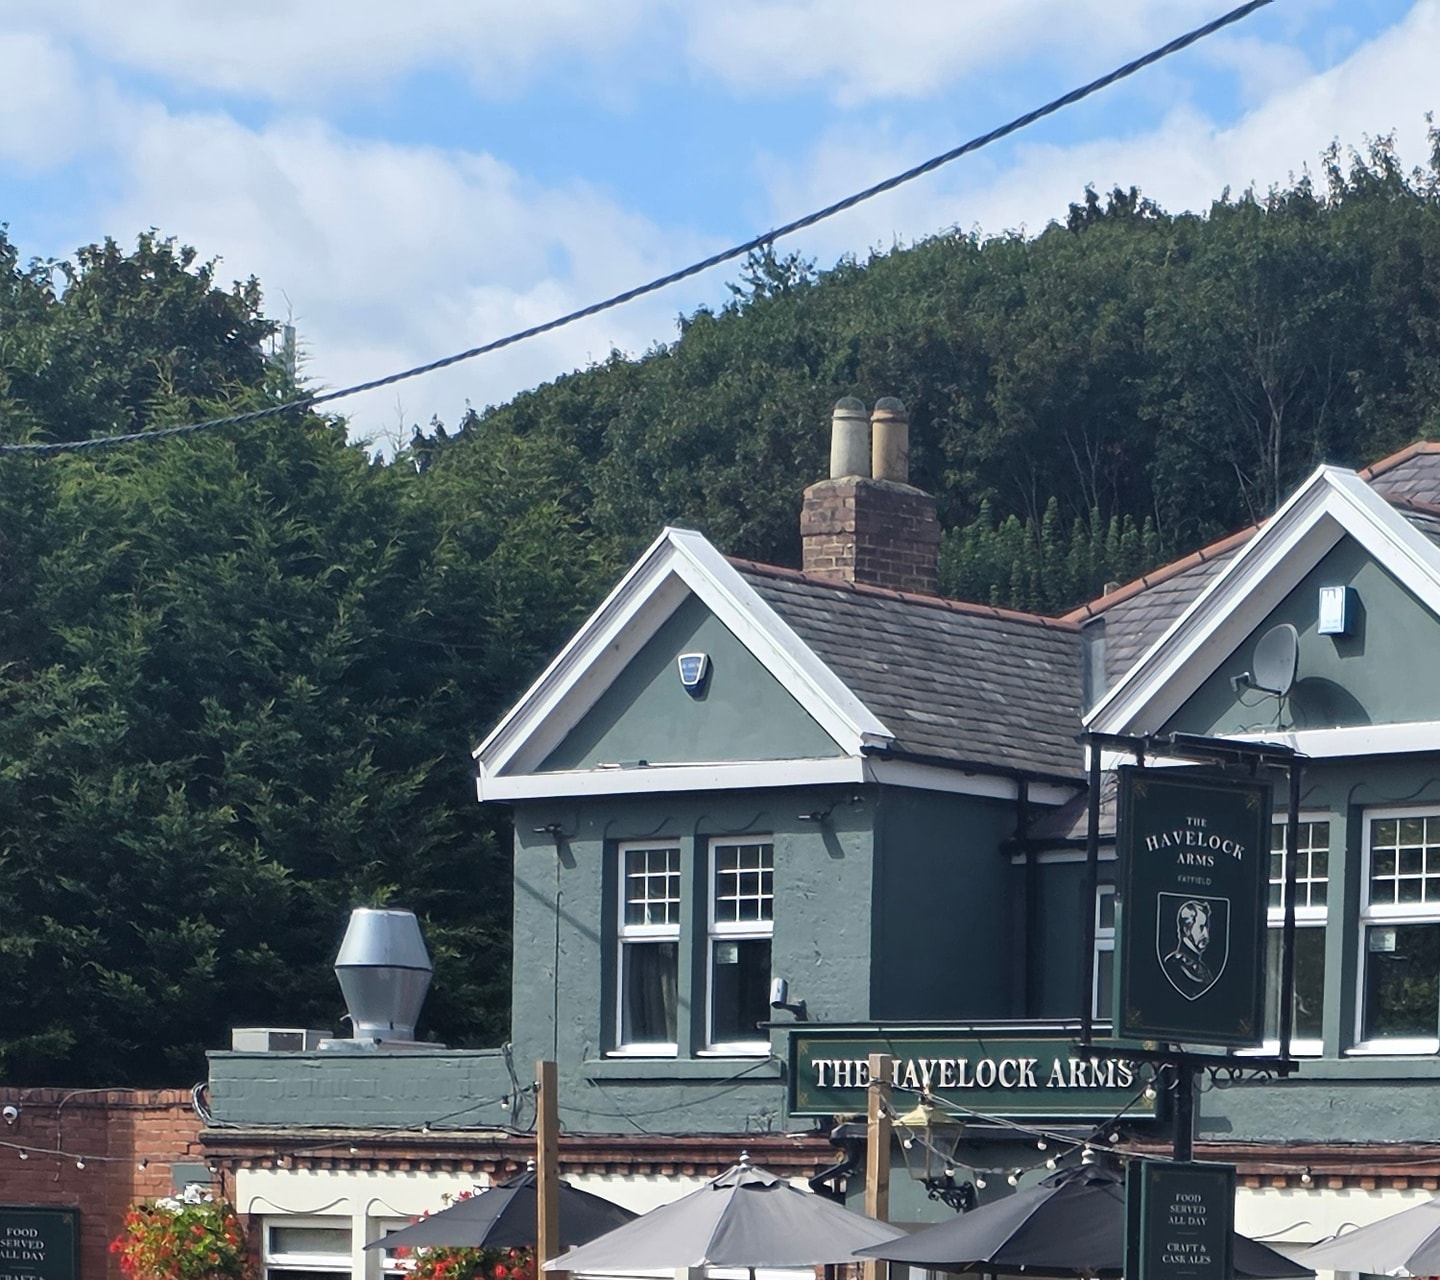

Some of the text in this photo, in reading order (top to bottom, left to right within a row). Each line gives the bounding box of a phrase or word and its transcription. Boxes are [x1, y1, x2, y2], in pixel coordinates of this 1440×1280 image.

[1186, 816, 1207, 828] THE
[1145, 831, 1246, 861] HAVELOCK
[1177, 853, 1215, 867] ARMS
[1178, 875, 1212, 886] FATFIELD
[811, 1059, 870, 1088] THE
[1046, 1058, 1134, 1088] ARMS
[1175, 1193, 1202, 1203] FOOD
[1169, 1205, 1206, 1215] SERVED
[1168, 1216, 1207, 1226] ALL DAY
[6, 1227, 38, 1238] FOOD
[1167, 1242, 1199, 1253] CRAFT
[22, 1251, 45, 1261] DAY
[1162, 1254, 1211, 1265] CASK ALES
